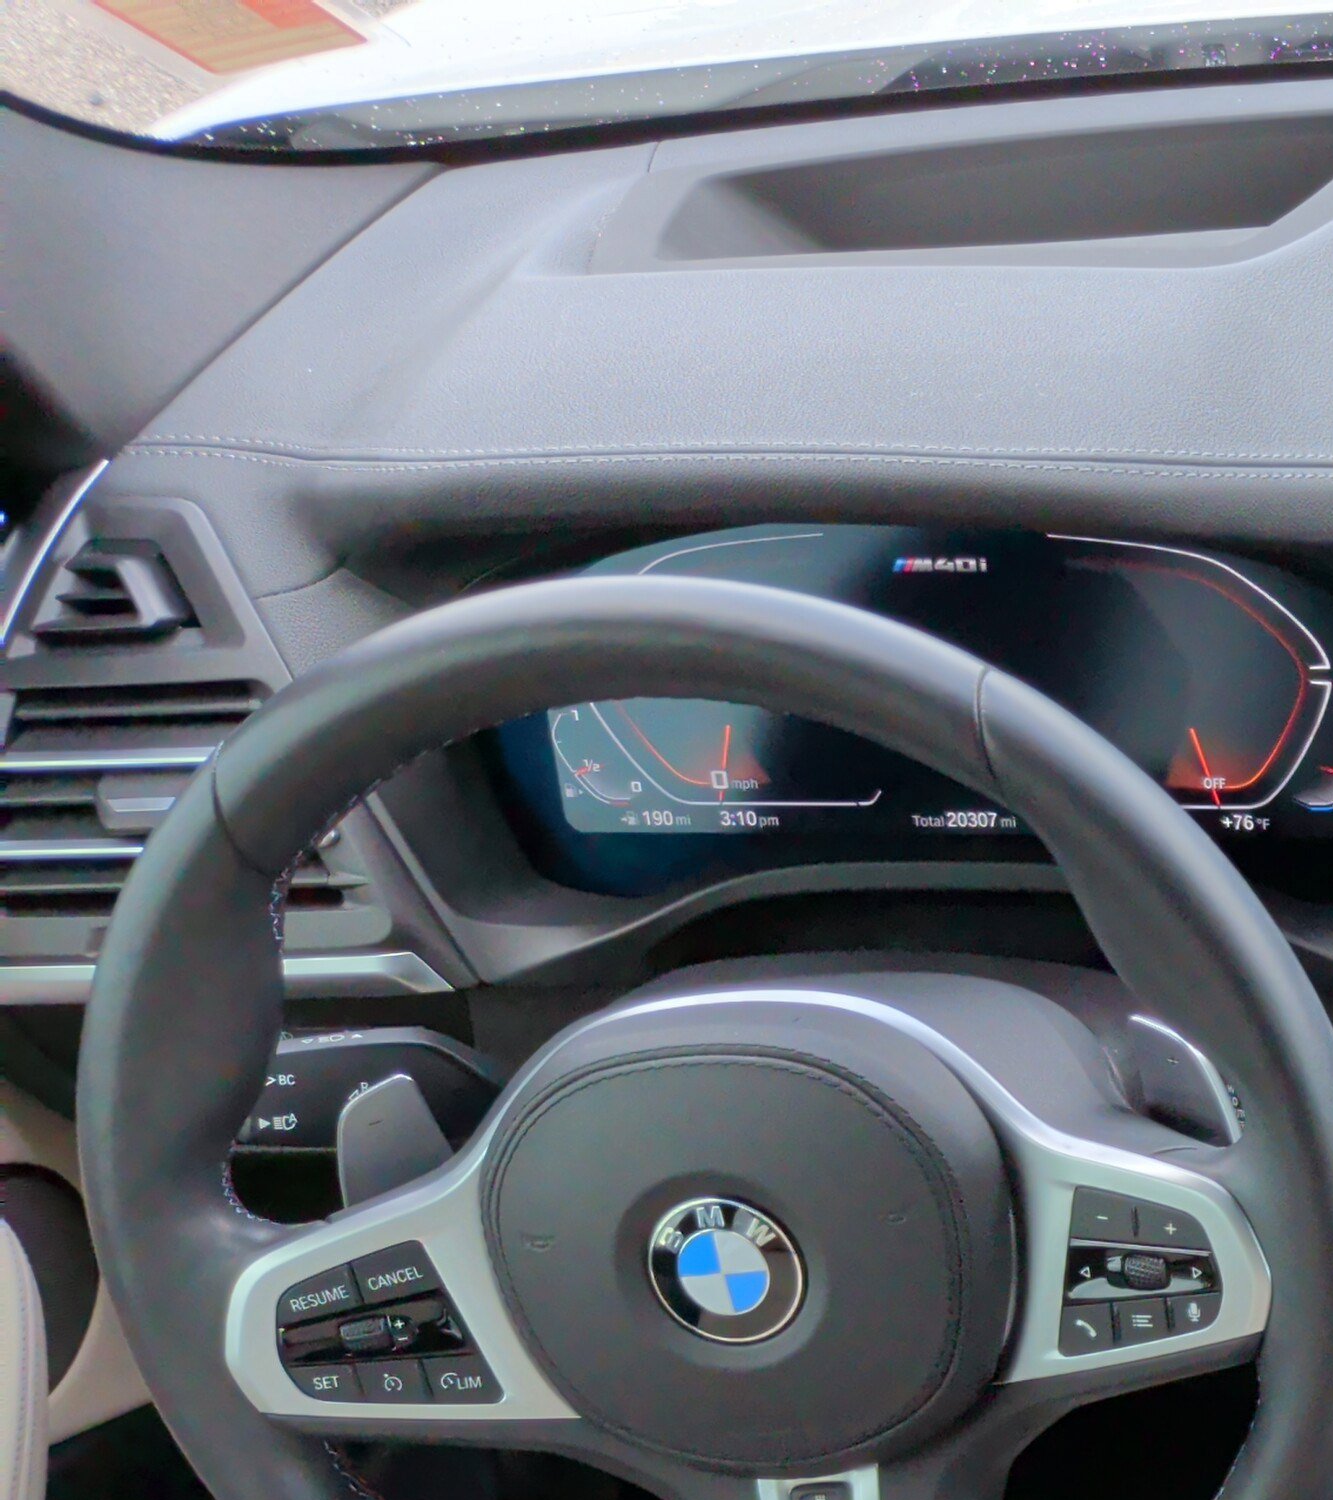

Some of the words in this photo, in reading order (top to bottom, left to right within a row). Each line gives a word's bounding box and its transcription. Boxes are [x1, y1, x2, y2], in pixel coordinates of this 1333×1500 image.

[731, 779, 759, 791] mph
[1203, 777, 1226, 790] OFF
[641, 811, 673, 827] 190
[675, 814, 692, 826] mi
[719, 810, 757, 827] 3:10
[759, 815, 779, 829] pm
[912, 815, 944, 828] Total
[946, 812, 997, 828] 20307
[1000, 816, 1017, 828] mi
[658, 1205, 776, 1253] BMW
[367, 1266, 423, 1292] CANCEL
[290, 1285, 349, 1312] RESUME
[313, 1375, 339, 1390] SET
[456, 1376, 482, 1391] LIM
